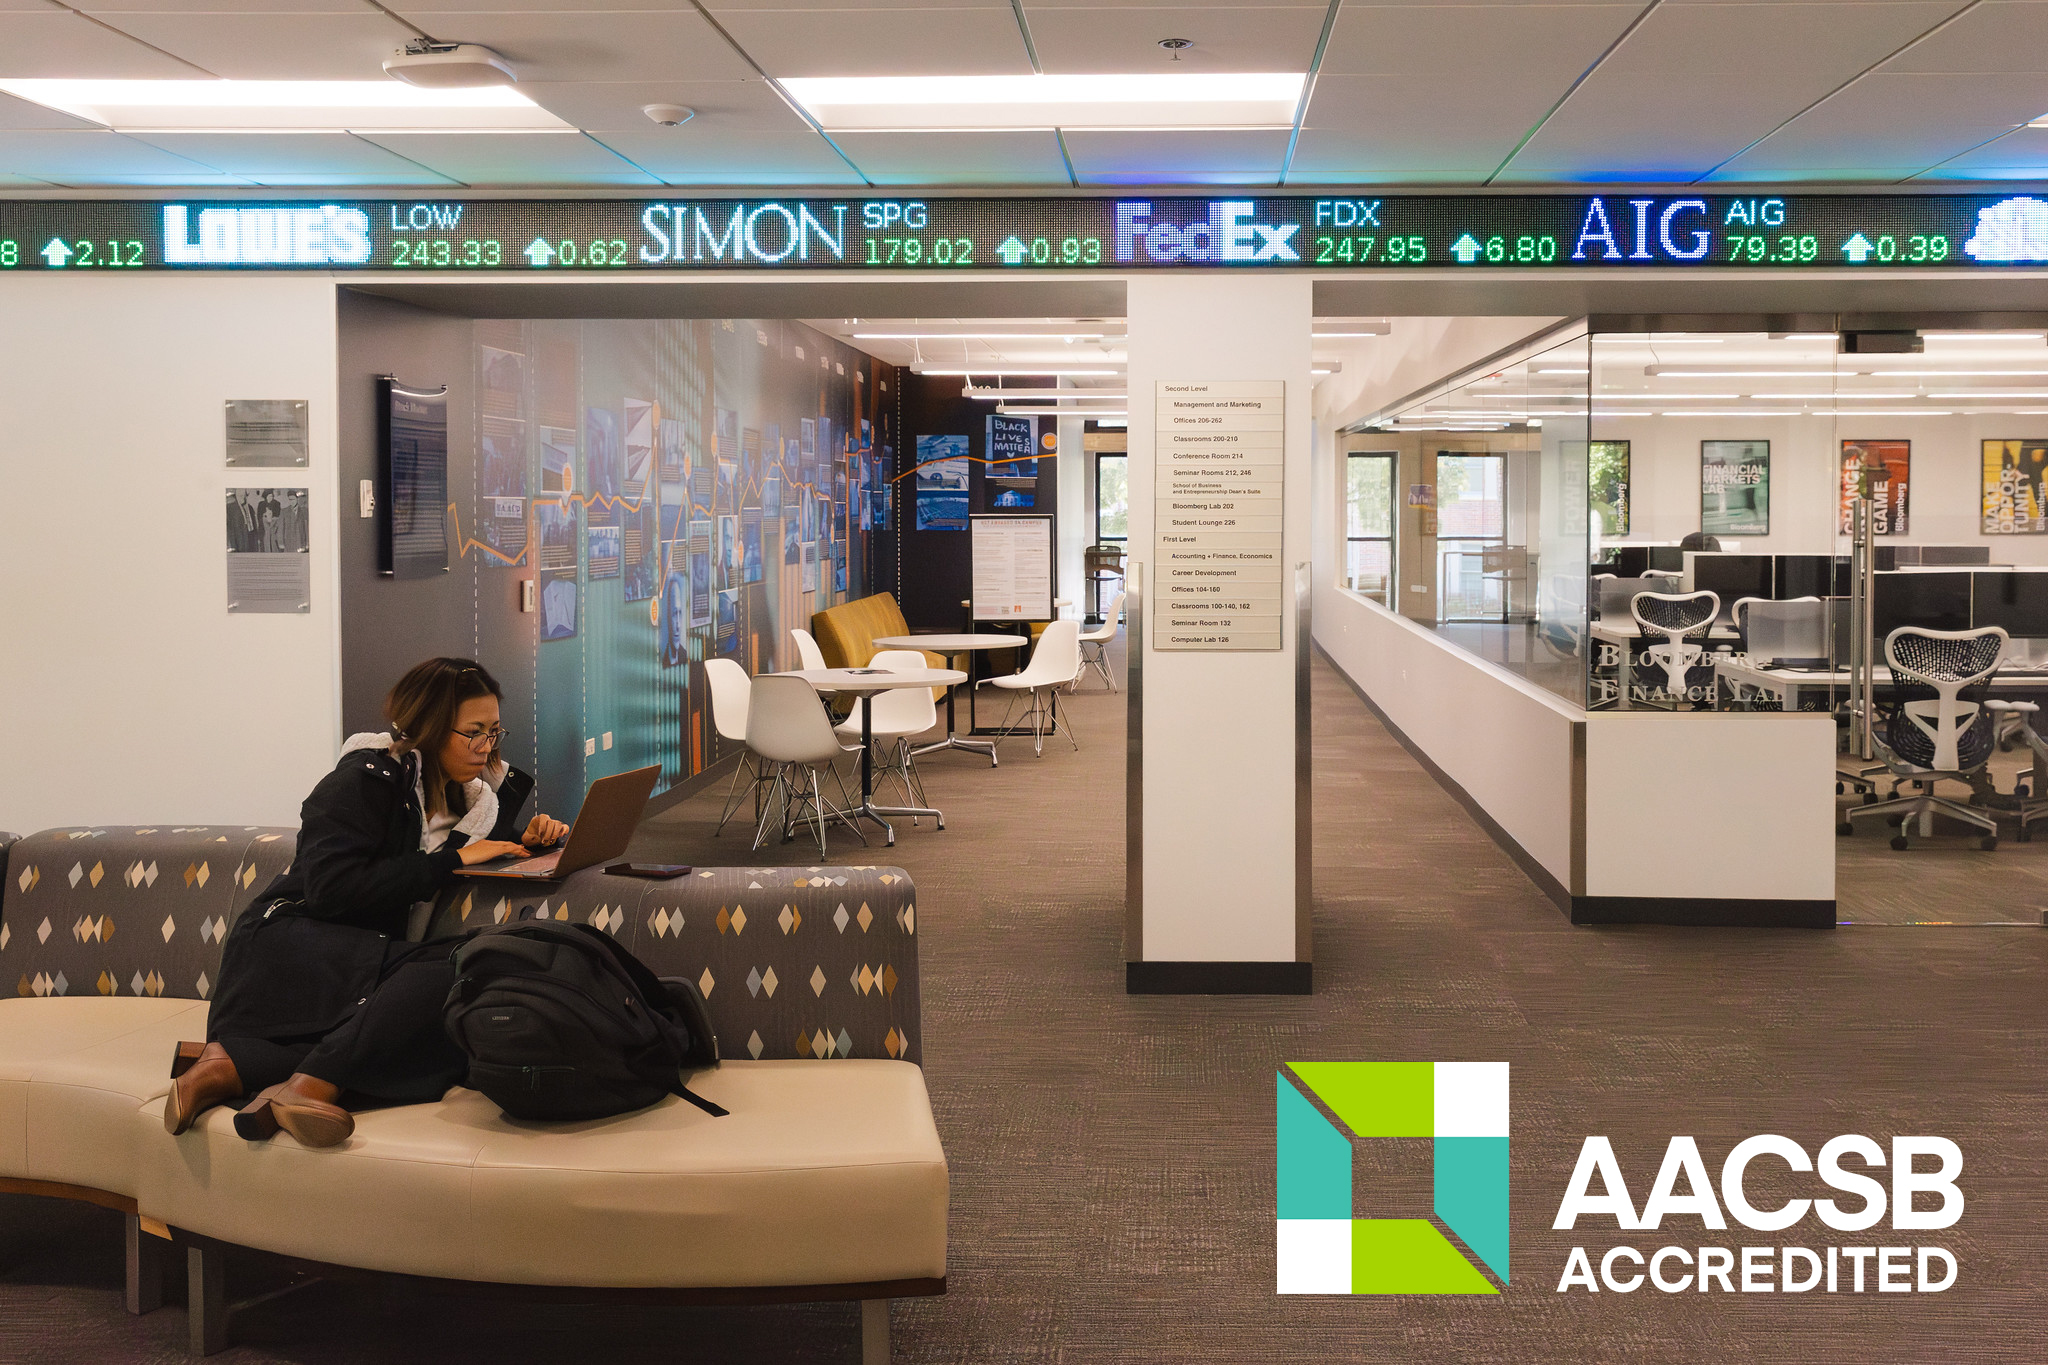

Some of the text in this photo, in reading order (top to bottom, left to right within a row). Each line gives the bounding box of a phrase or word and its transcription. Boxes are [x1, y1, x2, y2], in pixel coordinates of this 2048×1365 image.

[392, 204, 463, 230] LOW
[863, 202, 927, 229] SPG
[1316, 200, 1381, 228] FDX
[1724, 199, 1786, 227] AIG
[163, 203, 372, 264] LOWE'S
[639, 203, 847, 264] SIMON
[1114, 200, 1301, 263] FedEx
[1572, 197, 1712, 261] AIG
[75, 240, 144, 266] 2.12
[391, 240, 501, 266] 243.33
[558, 240, 628, 266] 0.62
[864, 238, 974, 265] 179.02
[1032, 238, 1102, 265] 0.93
[1316, 236, 1427, 263] 247.95
[1486, 236, 1557, 262] 6.80
[1727, 235, 1819, 262] 79.39
[1876, 235, 1949, 262] 0.39
[1173, 401, 1215, 409] Management
[1230, 401, 1261, 409] Marketing
[994, 420, 1028, 433] BLACK
[994, 442, 1031, 454] MATTER
[1172, 452, 1210, 460] Conference
[1173, 469, 1199, 477] Seminar
[1201, 469, 1224, 477] Rooms
[1703, 464, 1767, 475] FINANCIAL
[1703, 474, 1761, 485] MARKETS
[1703, 484, 1725, 494] LAB
[1844, 458, 1861, 534] CHANGE
[1172, 503, 1208, 511] Bloomberg
[1616, 483, 1627, 532] Bloomberg
[1873, 481, 1888, 535] GAME
[1895, 482, 1907, 532] Bloomberg
[1985, 482, 2000, 534] MAKE
[2014, 472, 2031, 533] TUNITY
[1199, 519, 1223, 527] Lounge
[1730, 522, 1767, 533] Bloomberg
[1195, 569, 1237, 577] Development
[1171, 619, 1198, 627] Seminar
[1171, 636, 1203, 644] Computer
[1598, 644, 1762, 668] BLOOMBER
